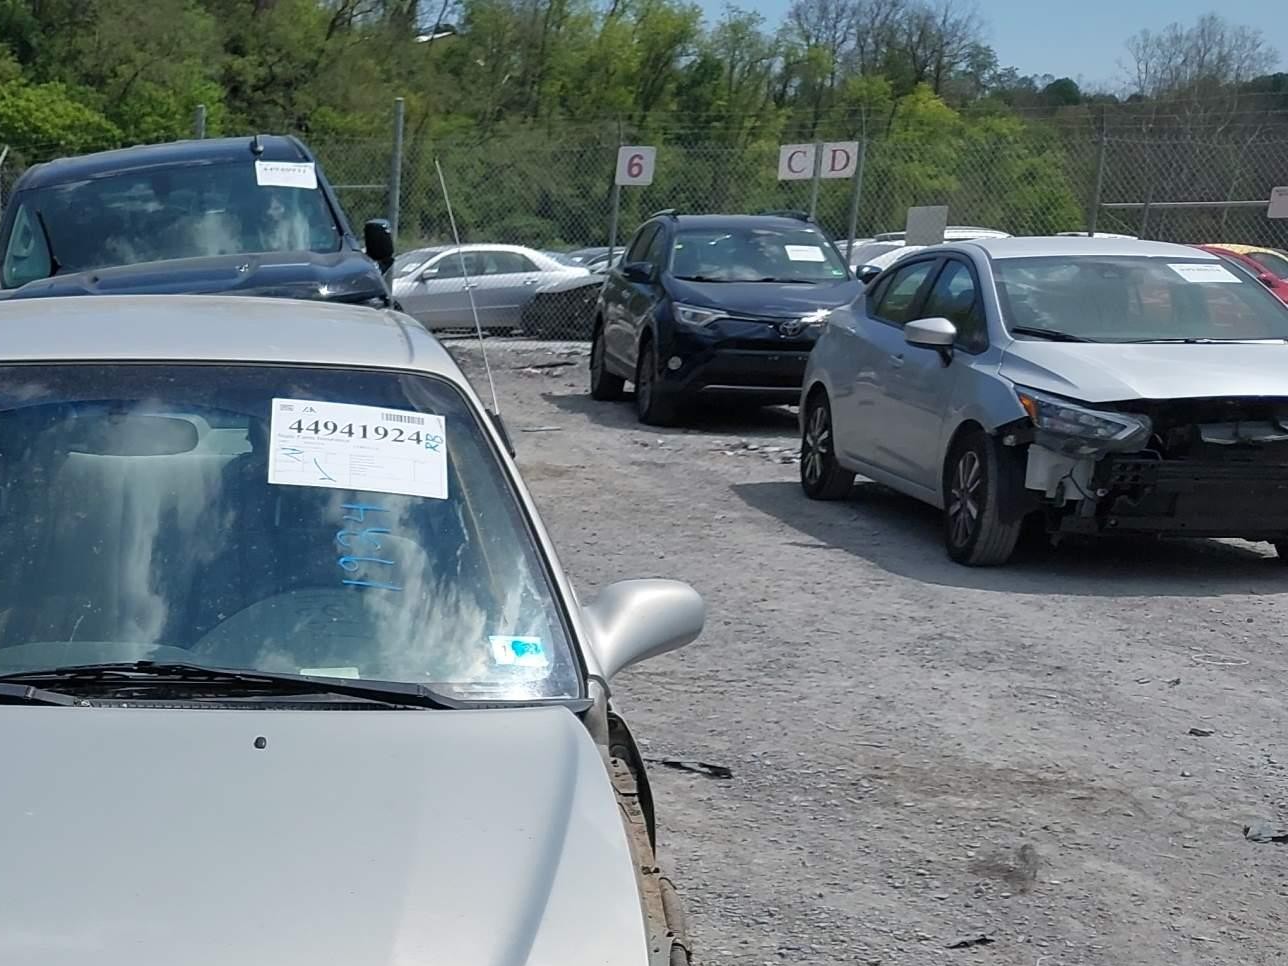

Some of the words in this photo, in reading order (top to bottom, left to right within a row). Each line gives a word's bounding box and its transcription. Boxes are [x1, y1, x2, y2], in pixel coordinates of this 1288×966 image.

[626, 153, 645, 179] 6
[786, 149, 808, 174] C
[828, 148, 851, 172] D
[288, 418, 424, 445] 44941924
